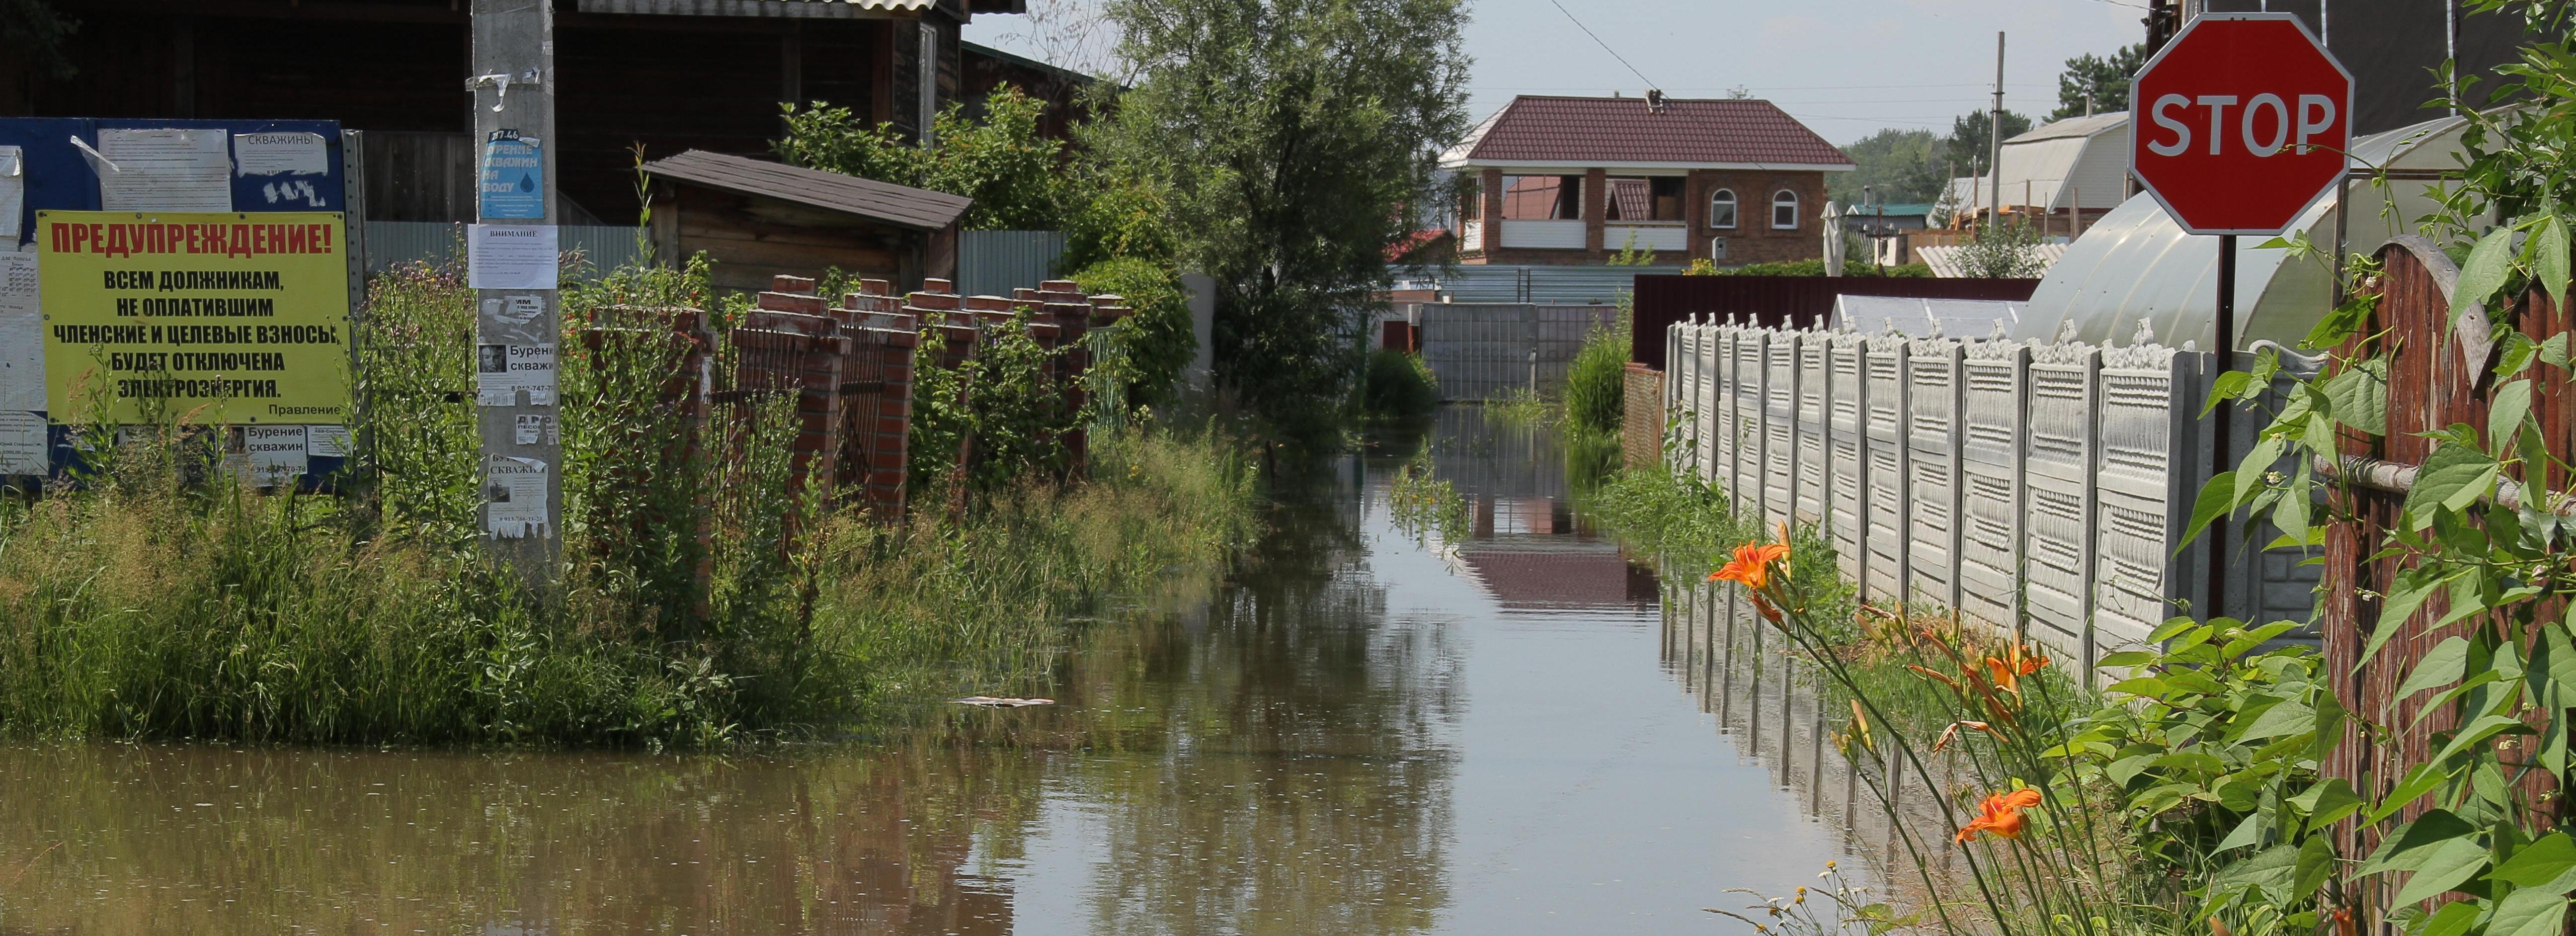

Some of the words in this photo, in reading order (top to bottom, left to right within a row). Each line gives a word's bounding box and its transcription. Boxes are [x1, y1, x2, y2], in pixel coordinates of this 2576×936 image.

[2147, 93, 2335, 157] STOP
[248, 135, 313, 145] СКВАЖИНЫ
[483, 170, 498, 180] НА
[483, 182, 514, 192] ВОДУ
[51, 223, 331, 258] ПРЕДУПРЕЖДЕНИЕ!
[104, 271, 154, 290] ВСЕМ
[159, 271, 284, 292] ДОЛЖНИКАМ,
[117, 298, 138, 317] НЕ
[142, 298, 273, 317] ОПЛАТИВШИМ
[53, 325, 147, 343] ЧЛЕНСКИЕ
[151, 326, 162, 343] И
[167, 326, 252, 346] ЦЕЛЕВЫЕ
[111, 352, 168, 373] БУДЕТ
[172, 352, 285, 370] ОТКЛЮЧЕНА
[269, 405, 340, 417] Правление
[249, 427, 303, 439] Бурение
[249, 443, 303, 452] скважин
